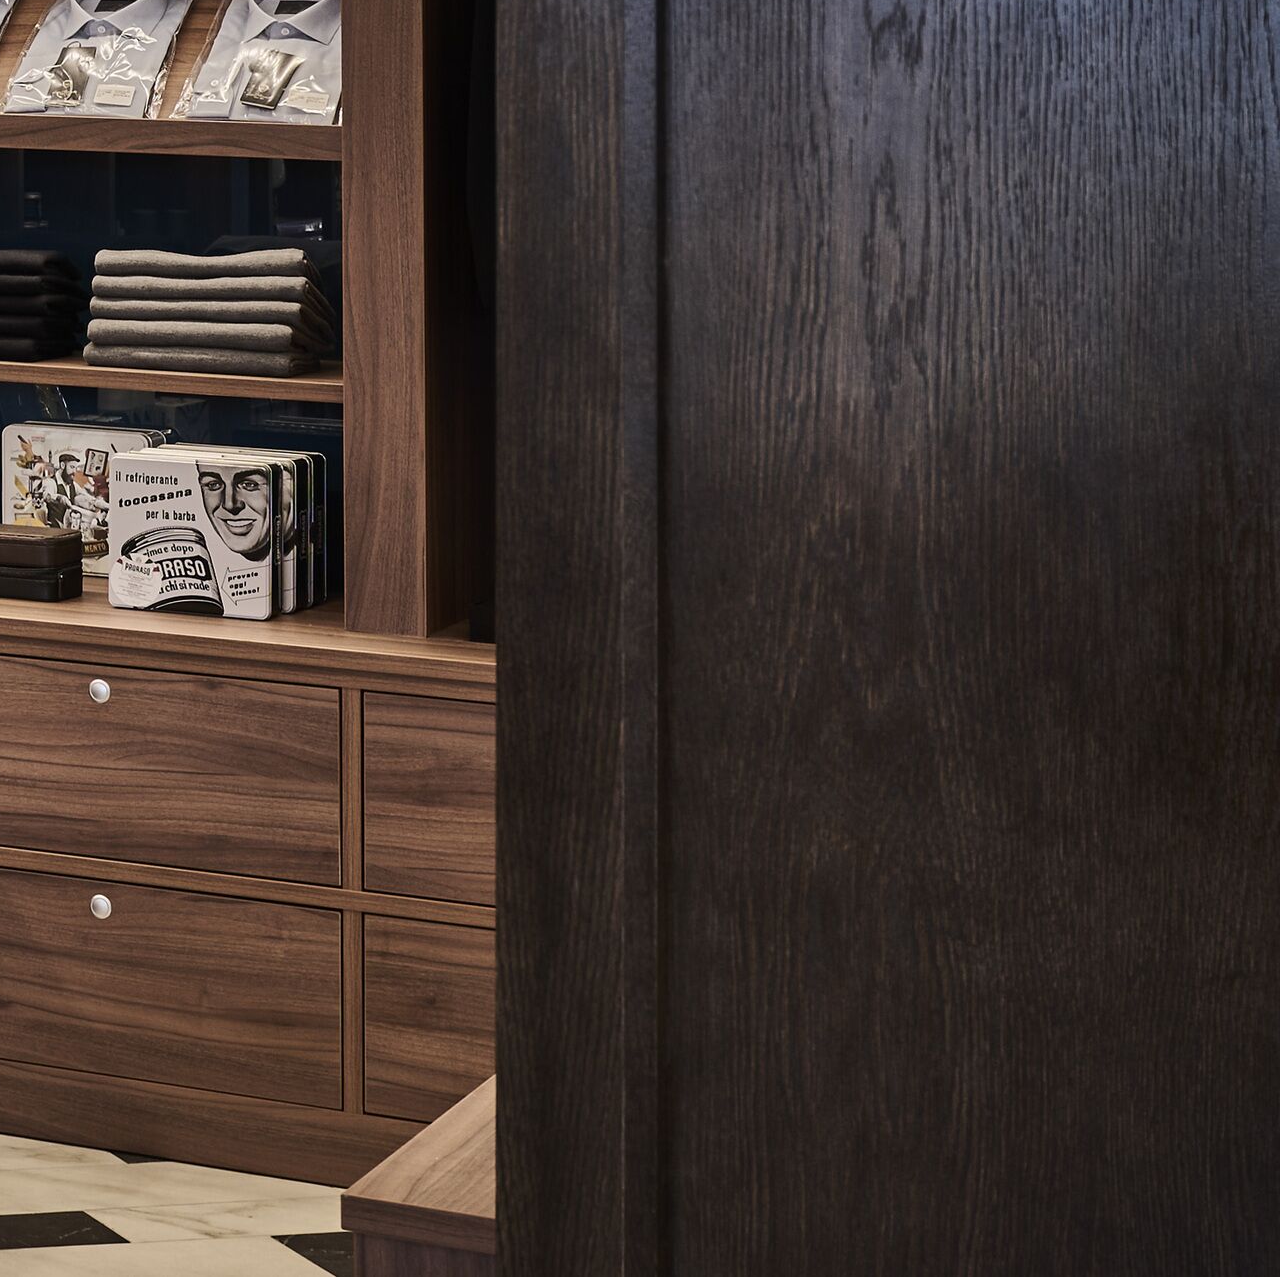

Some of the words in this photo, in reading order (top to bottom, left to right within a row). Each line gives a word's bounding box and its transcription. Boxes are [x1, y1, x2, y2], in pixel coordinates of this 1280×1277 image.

[116, 471, 121, 482] il
[126, 472, 178, 486] refrigerante
[118, 488, 192, 508] toccasana
[146, 510, 160, 521] per
[162, 510, 170, 520] la
[173, 510, 196, 522] barba
[146, 547, 163, 558] ima
[171, 544, 194, 554] dopo
[161, 560, 206, 580] RASO
[165, 582, 179, 593] chi
[178, 581, 188, 590] si
[189, 581, 210, 592] rade
